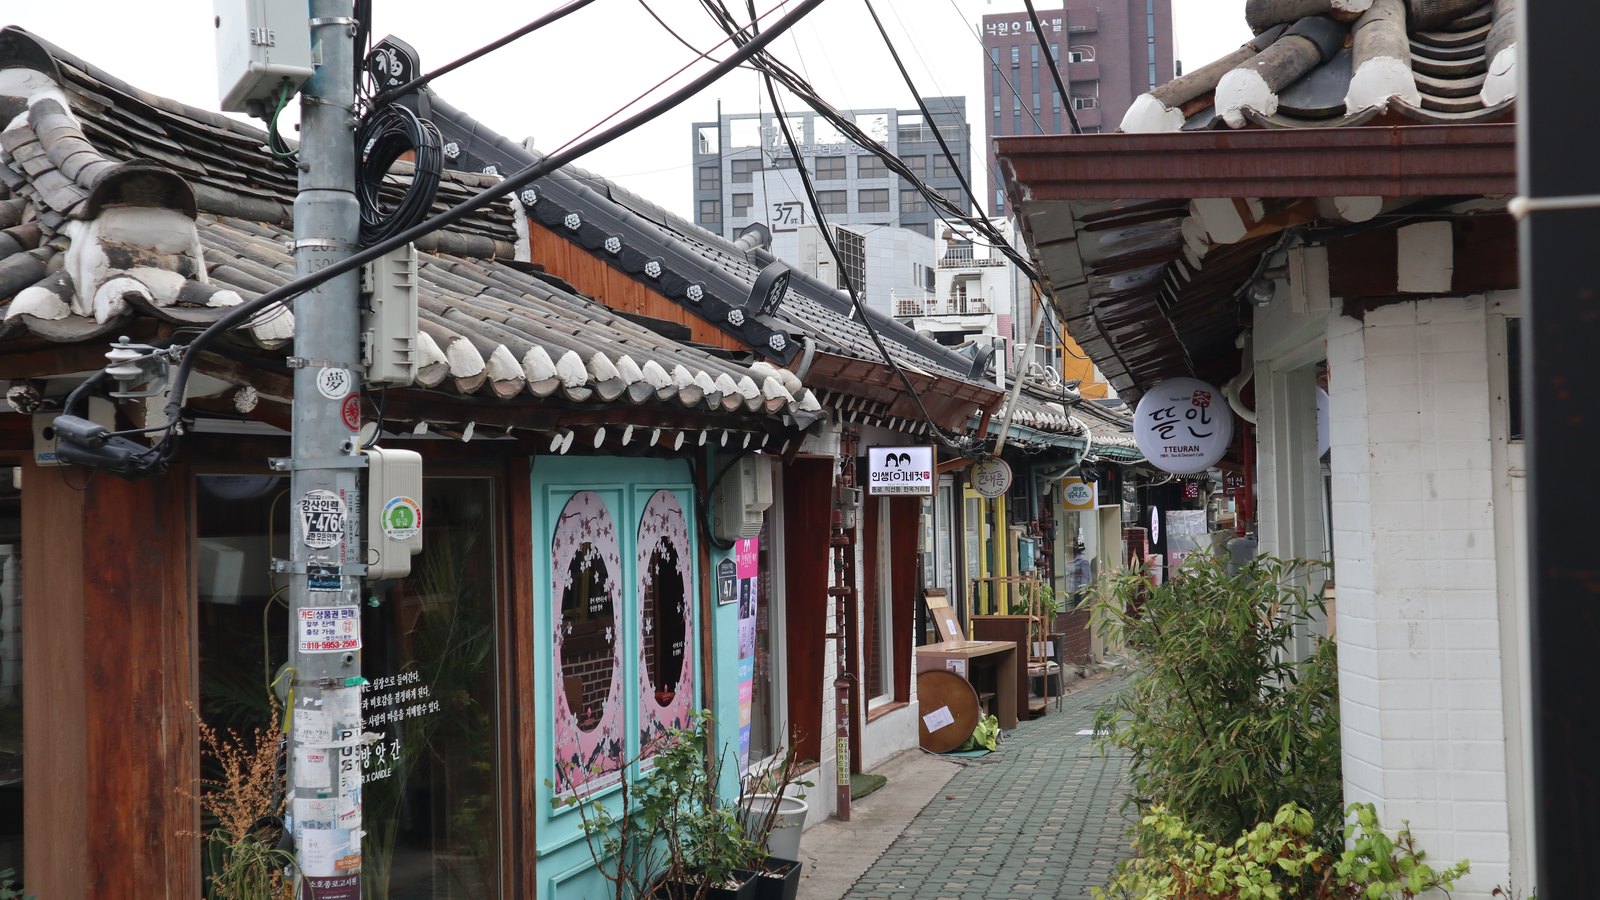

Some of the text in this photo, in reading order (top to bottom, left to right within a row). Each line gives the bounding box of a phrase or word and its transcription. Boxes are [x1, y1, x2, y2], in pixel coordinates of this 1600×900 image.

[772, 203, 792, 224] 37
[1163, 445, 1200, 453] TTEURAN
[302, 499, 339, 512] 강산인력
[723, 579, 733, 598] 47
[372, 675, 396, 691] 심장으로
[397, 670, 421, 686] 들어간다.
[394, 687, 417, 704] 결정하게
[417, 685, 431, 698] 된다.
[368, 712, 386, 728] 사람의
[387, 708, 405, 723] 마음을
[428, 700, 441, 713] 있다.
[371, 768, 392, 783] CANDLE
